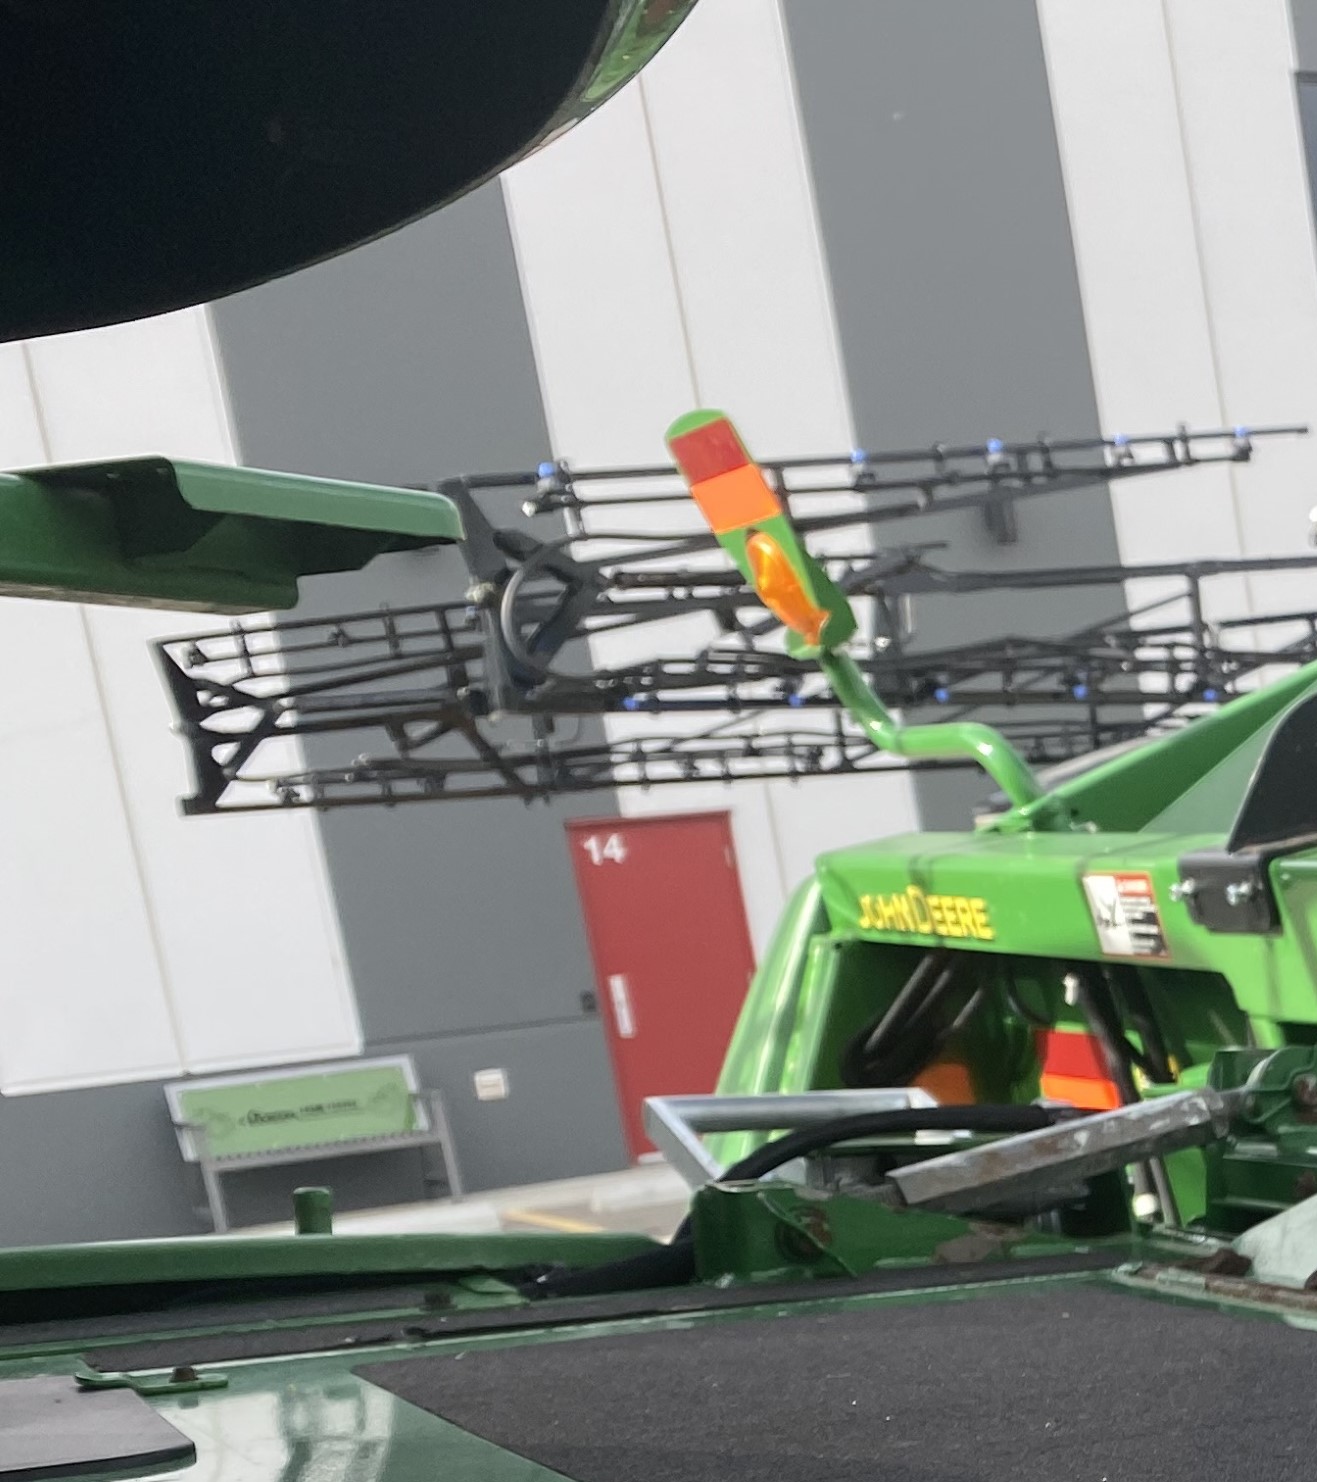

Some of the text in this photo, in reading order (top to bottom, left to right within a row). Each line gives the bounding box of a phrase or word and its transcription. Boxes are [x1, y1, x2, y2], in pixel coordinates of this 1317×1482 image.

[582, 832, 628, 867] 14
[858, 884, 996, 940] JOHN DEERE
